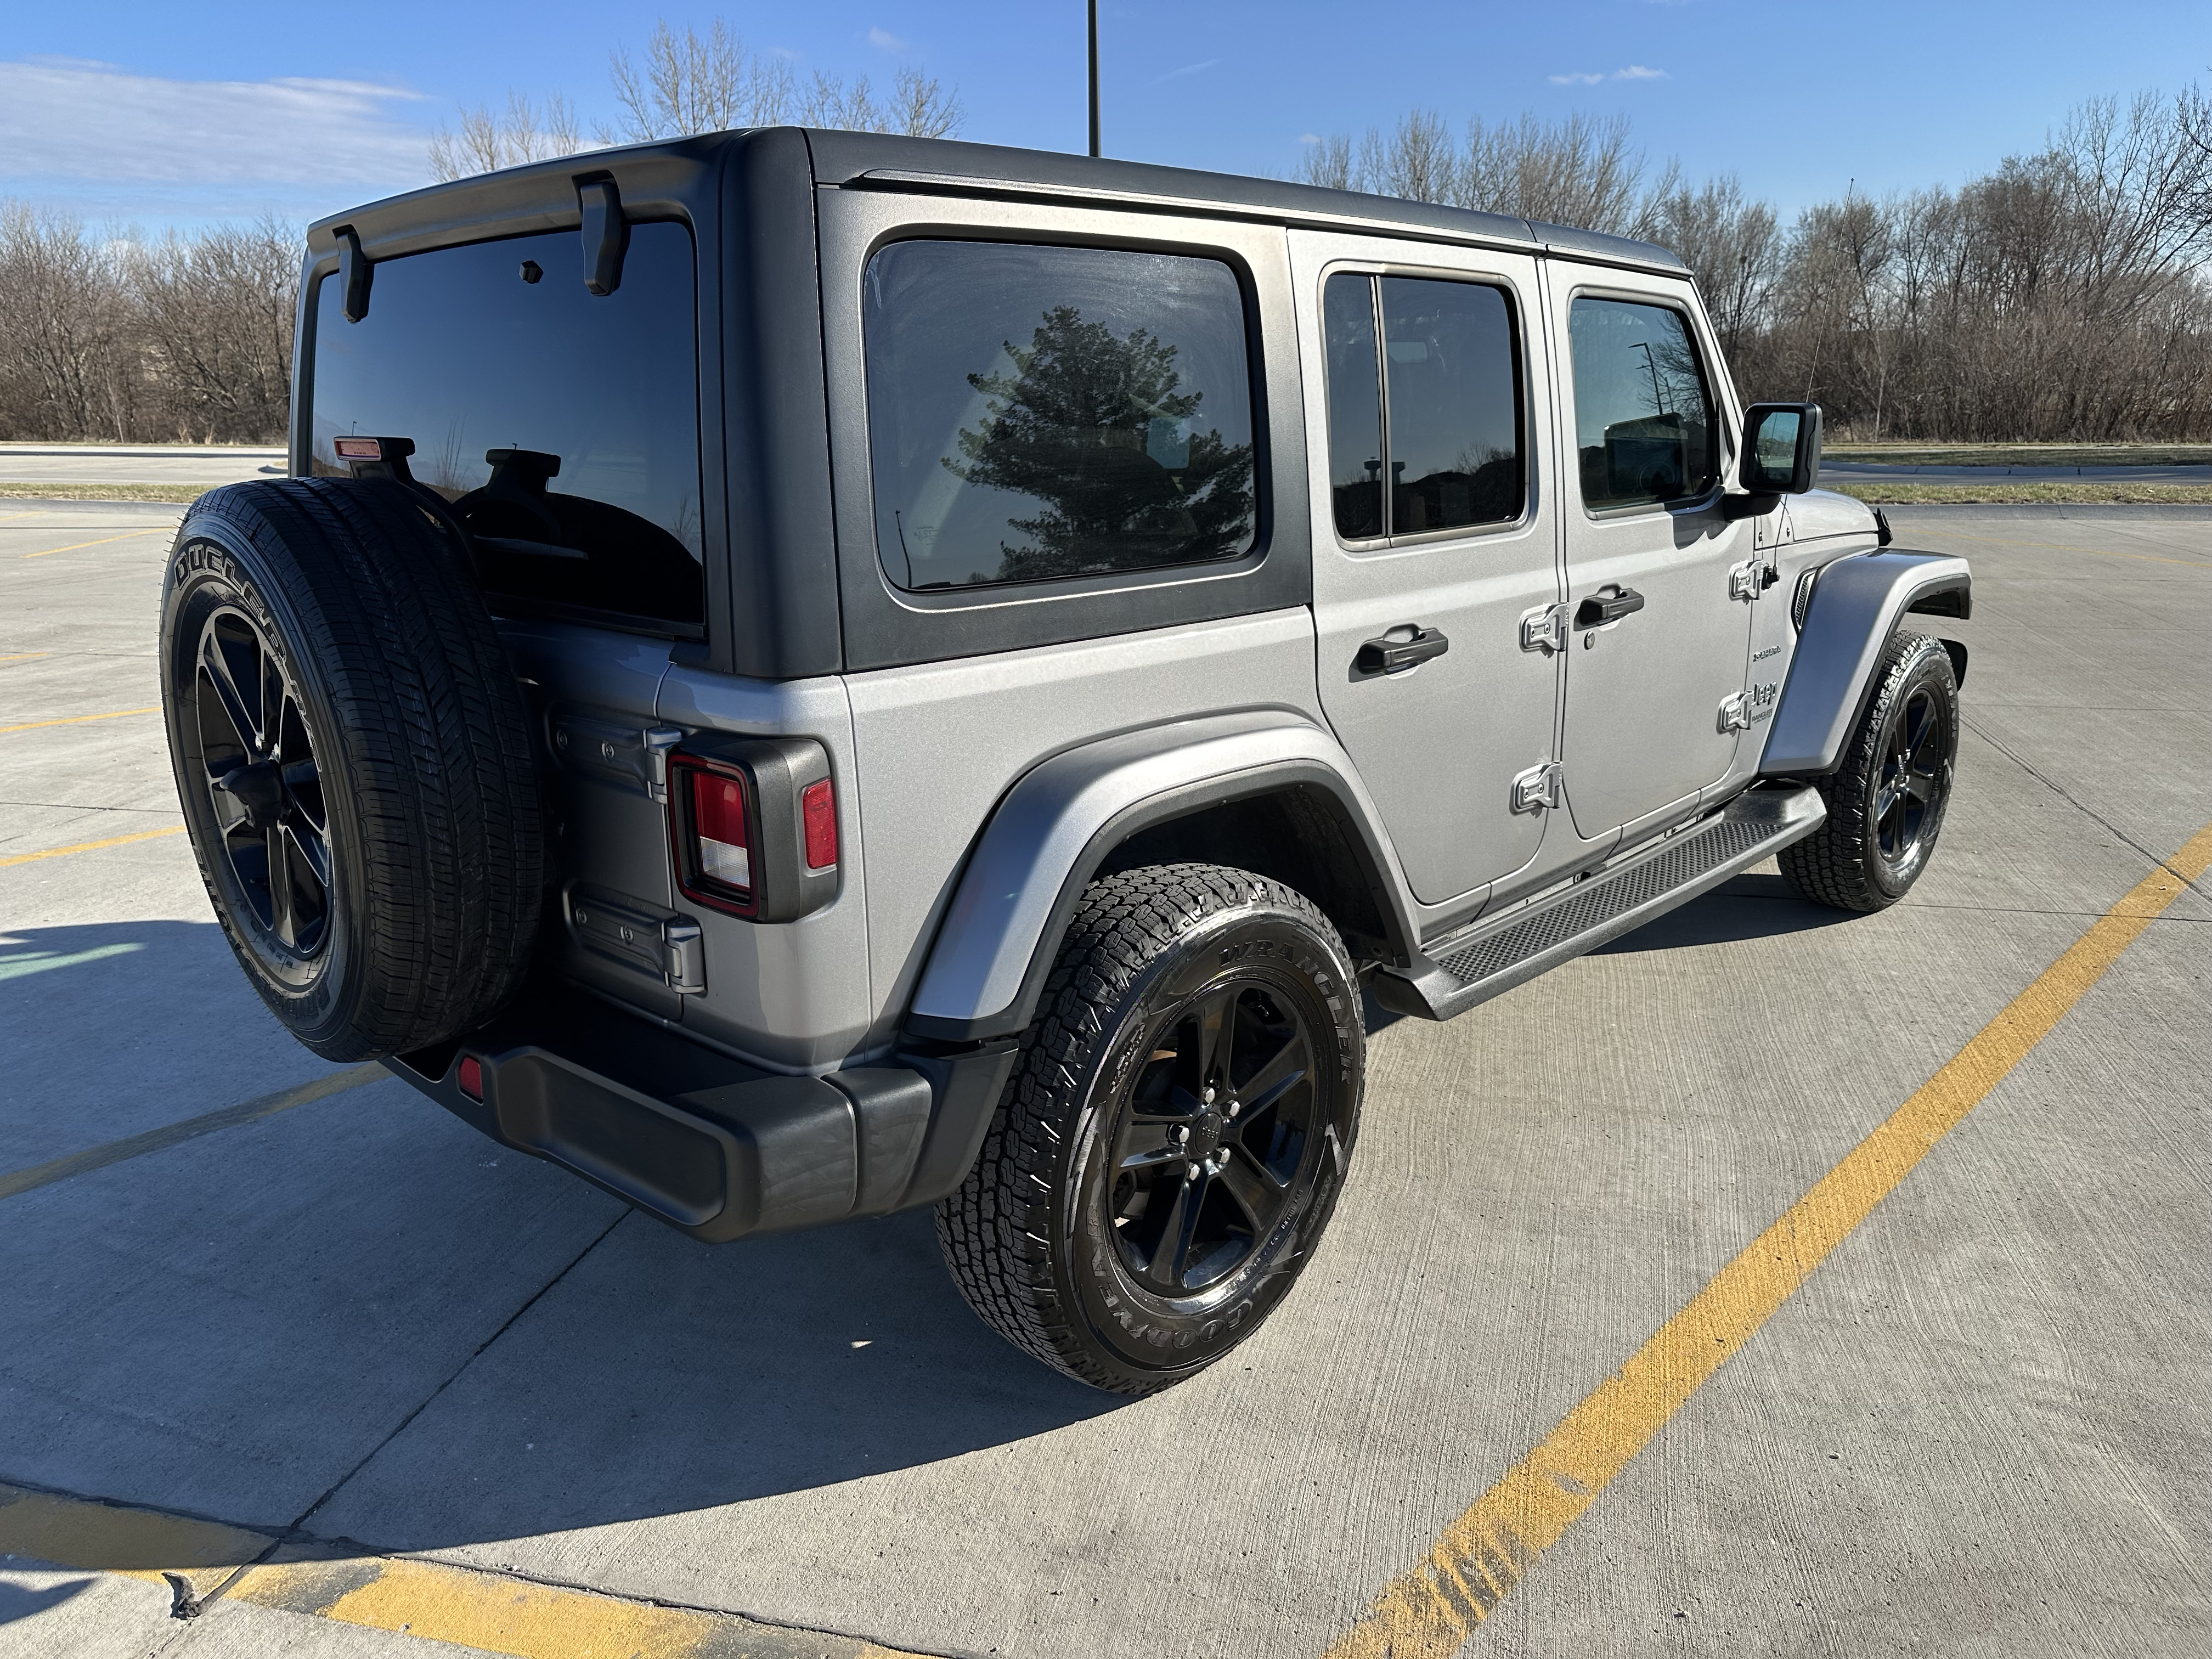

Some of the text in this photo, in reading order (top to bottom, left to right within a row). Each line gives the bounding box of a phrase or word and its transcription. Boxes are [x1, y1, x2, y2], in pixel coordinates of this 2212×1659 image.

[174, 543, 287, 663] DUELER
[1753, 645, 1781, 662] SAHARA
[1751, 681, 1777, 706] Jeep
[1752, 708, 1773, 722] RANGLER
[1219, 939, 1353, 1085] WRANGLER
[1087, 1203, 1252, 1348] GOODYEAR
